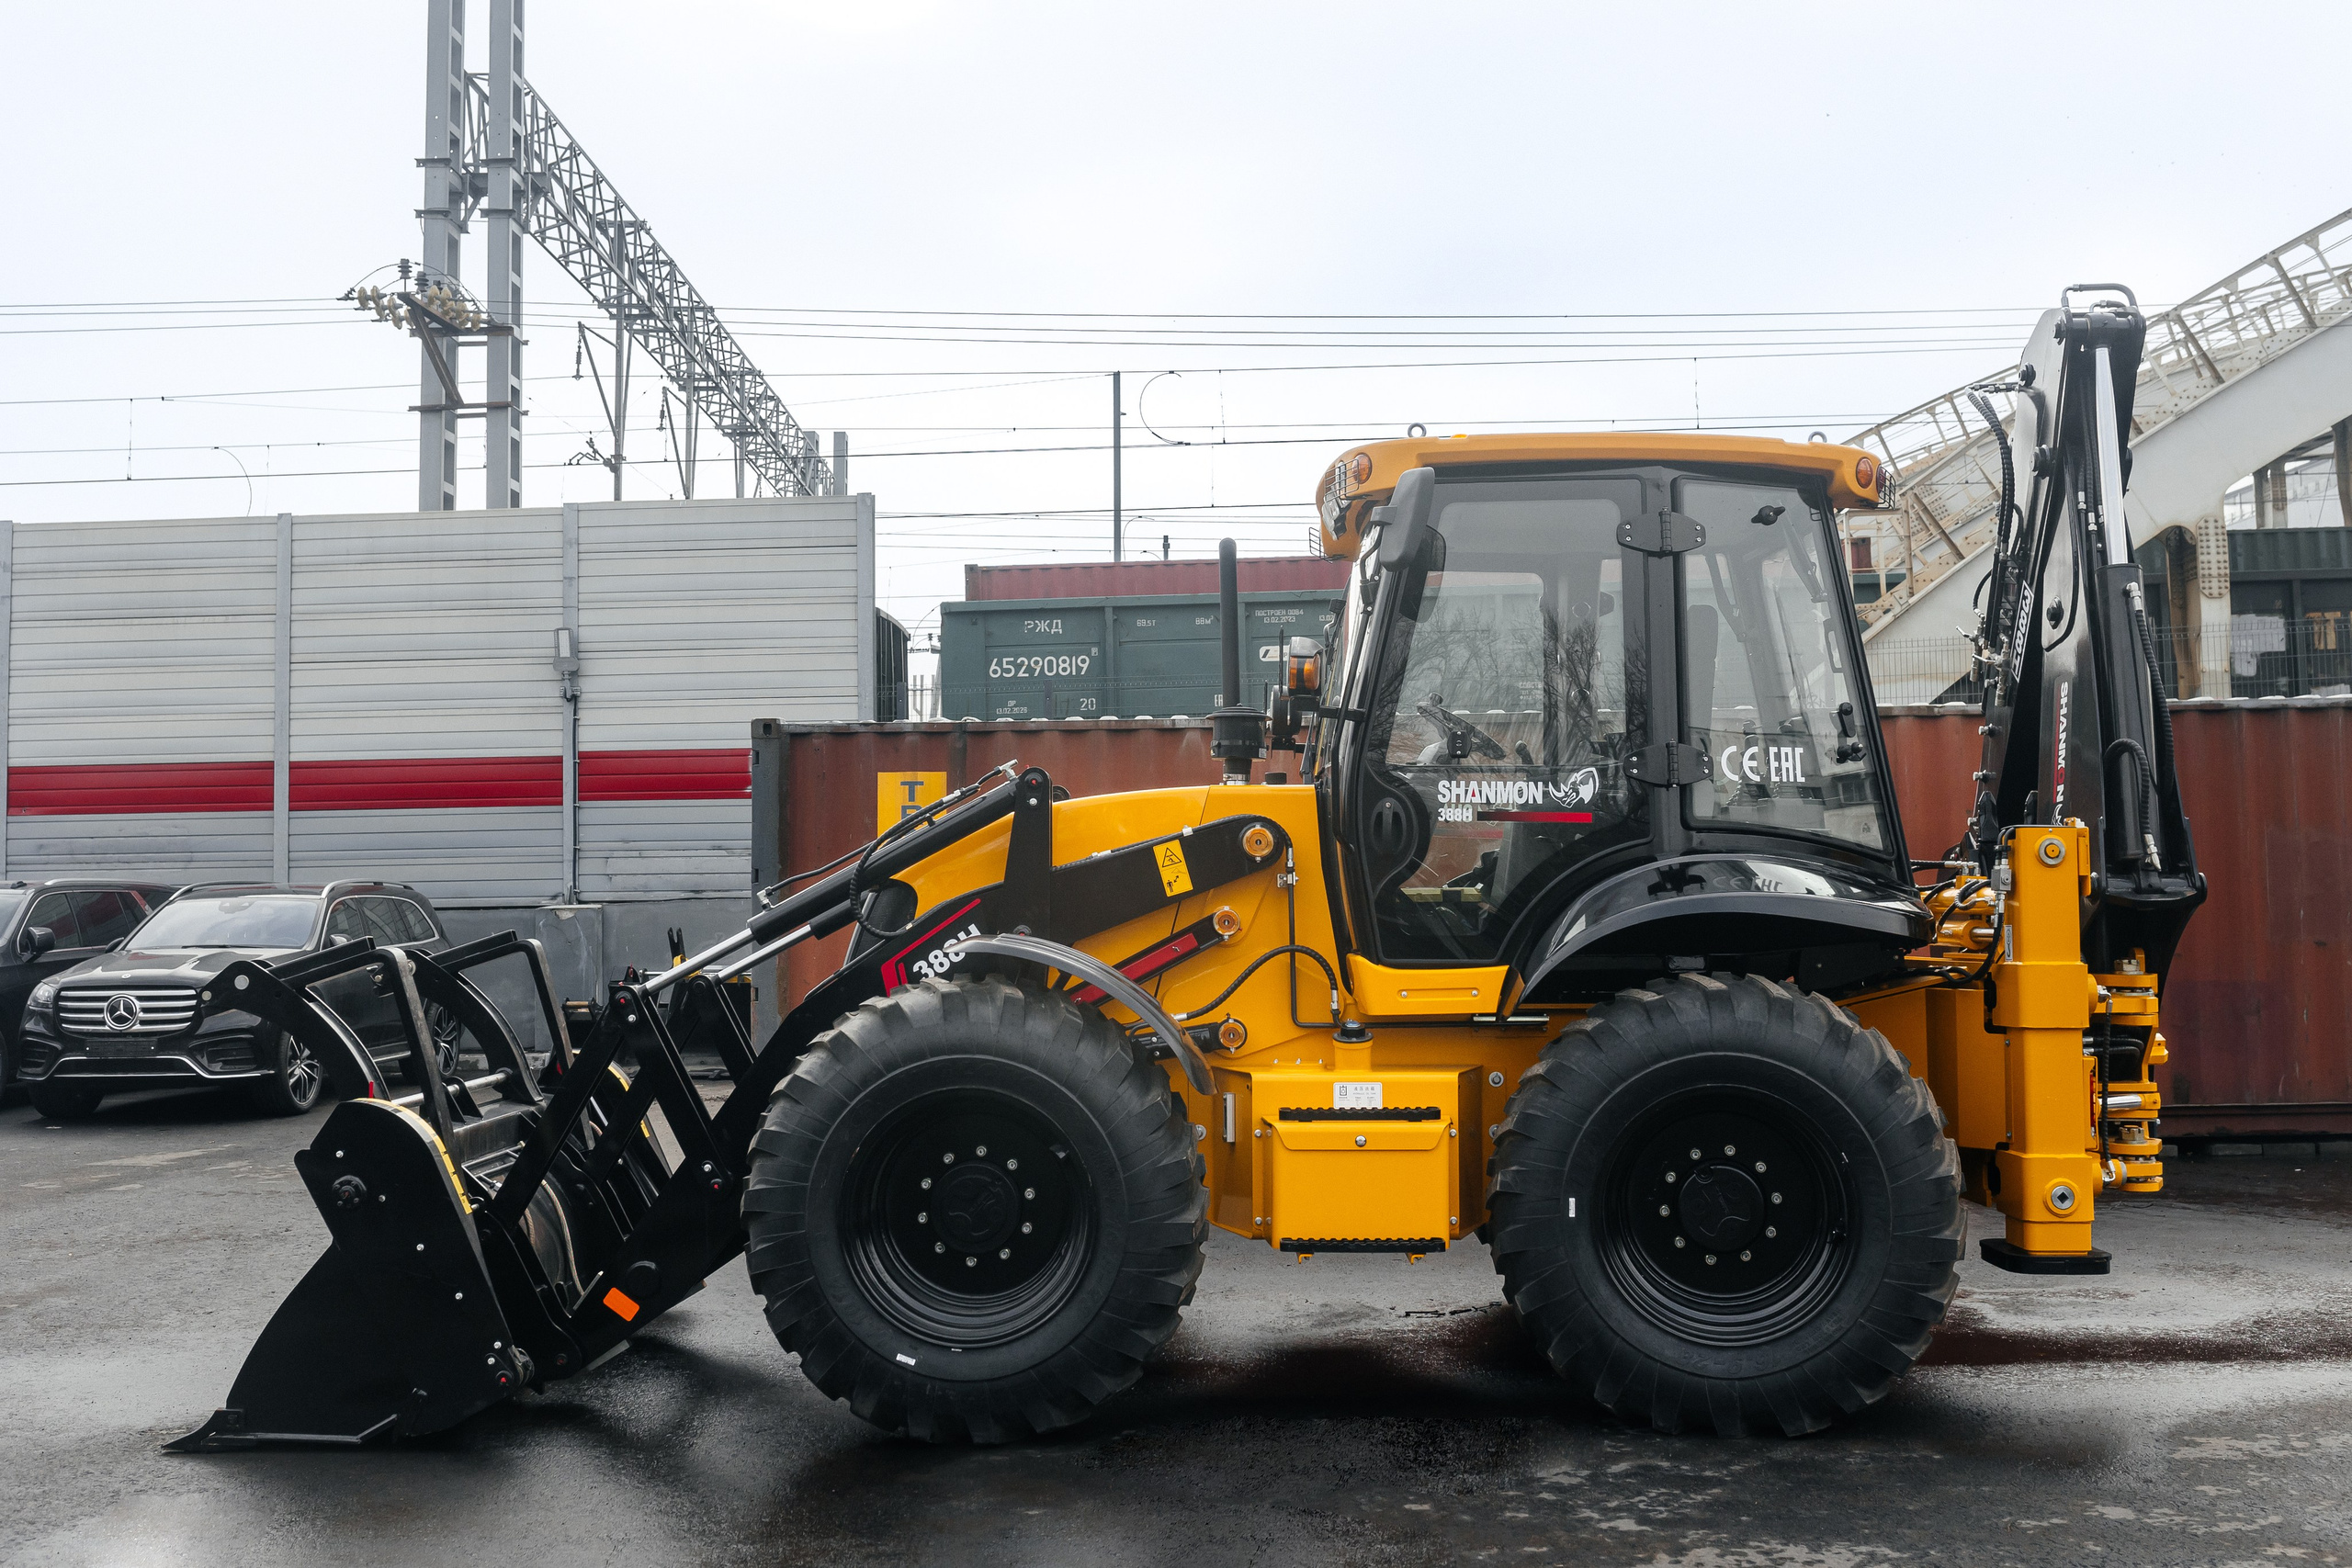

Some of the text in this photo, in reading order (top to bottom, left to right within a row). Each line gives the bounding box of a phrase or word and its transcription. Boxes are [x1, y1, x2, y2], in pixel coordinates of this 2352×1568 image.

[1024, 619, 1063, 635] РЖД
[2011, 589, 2031, 675] 388H
[989, 655, 1091, 678] 65290819
[1080, 698, 1096, 711] 20
[1214, 694, 1224, 707] EA
[2056, 681, 2069, 803] SHANMON
[1437, 780, 1544, 805] SHANMON
